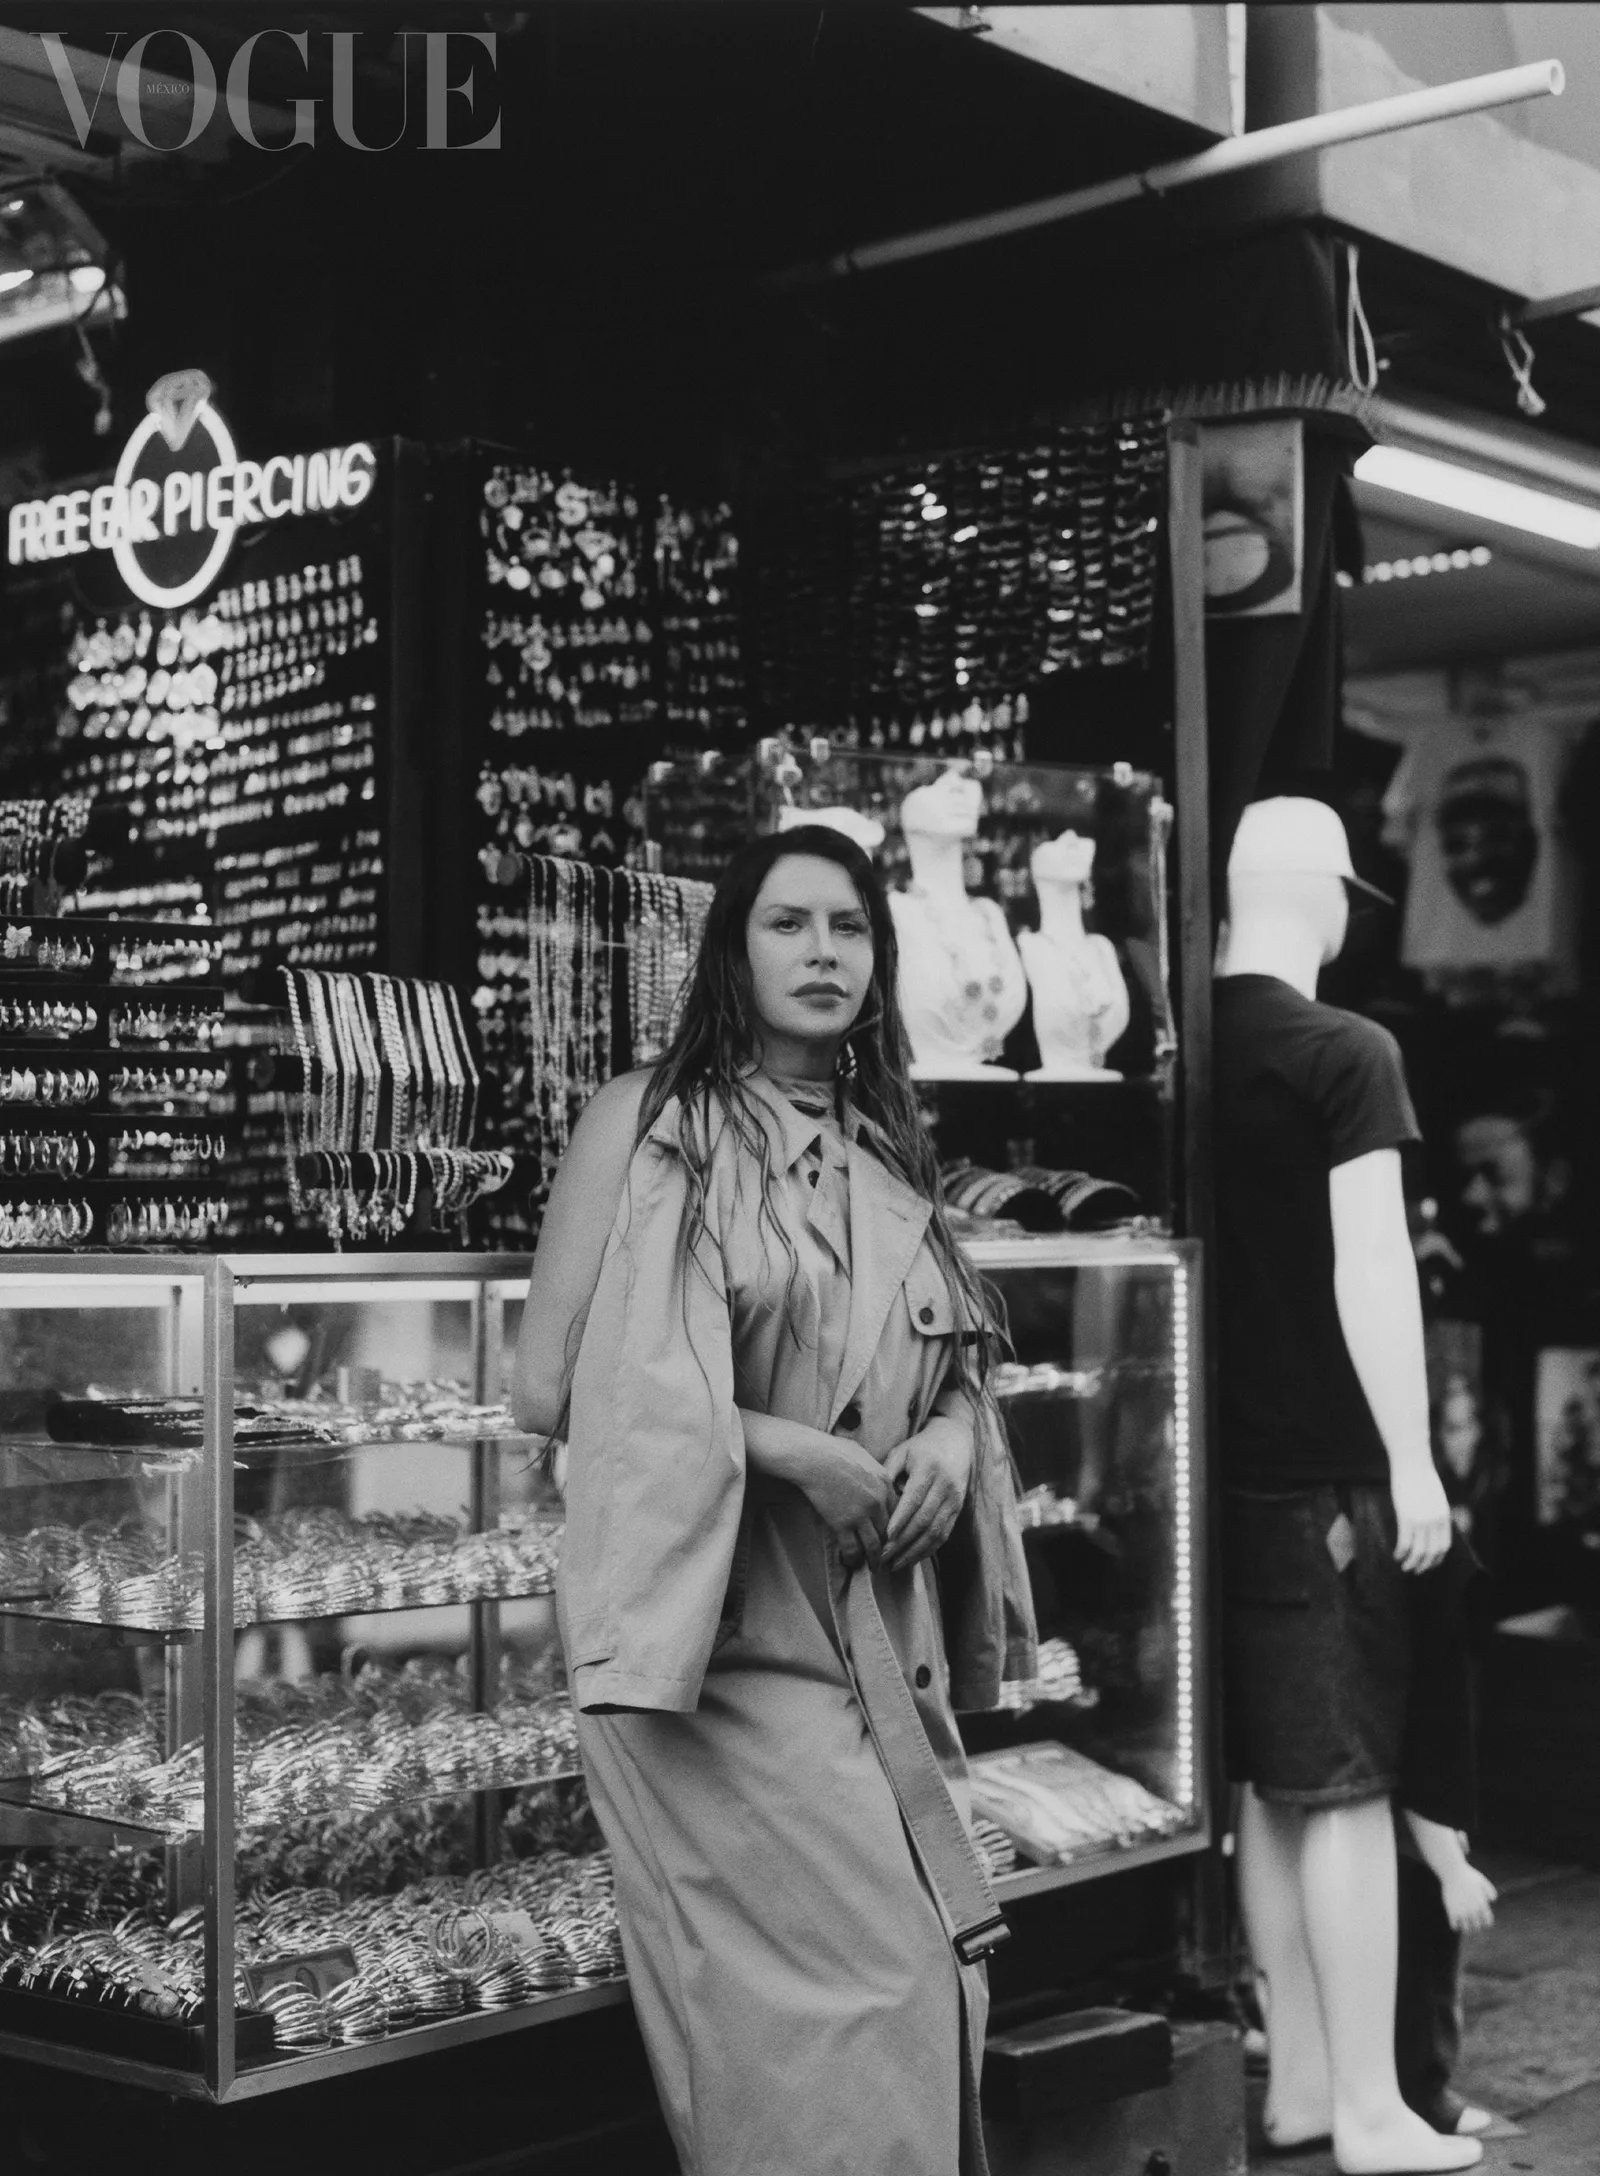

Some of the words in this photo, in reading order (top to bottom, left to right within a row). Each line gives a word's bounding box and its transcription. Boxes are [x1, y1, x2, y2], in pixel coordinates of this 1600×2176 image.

[8, 489, 91, 565] FREE
[90, 478, 160, 549] EAR
[163, 441, 376, 537] PIERCING
